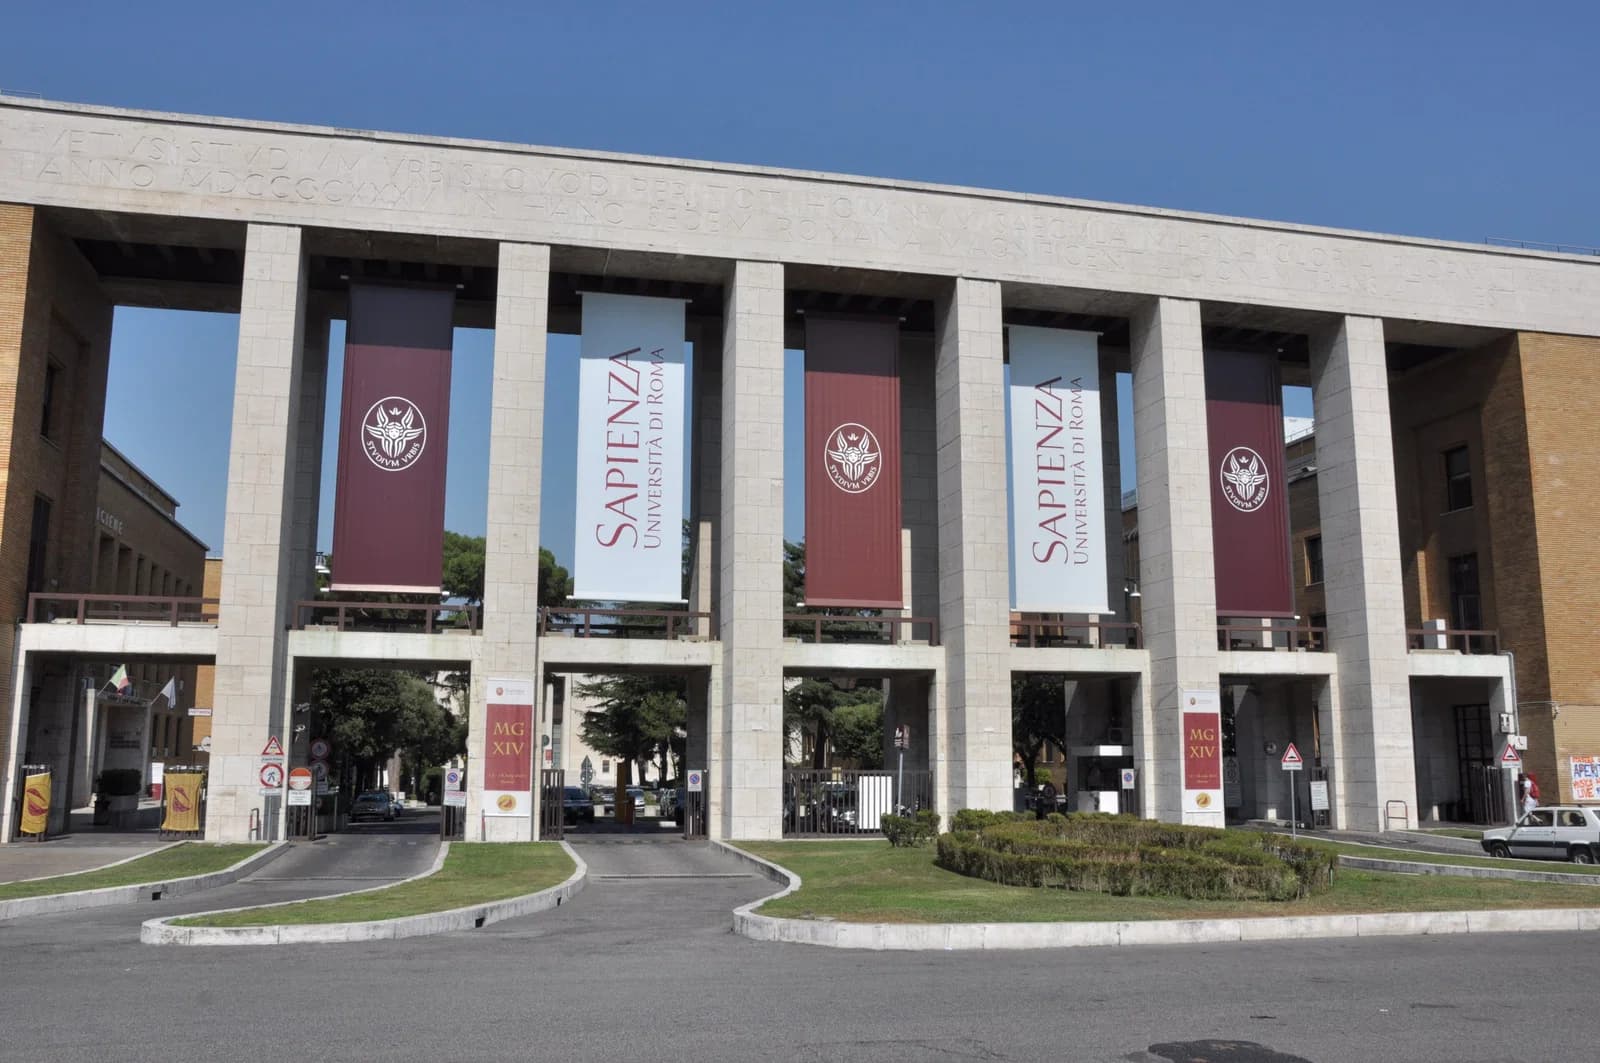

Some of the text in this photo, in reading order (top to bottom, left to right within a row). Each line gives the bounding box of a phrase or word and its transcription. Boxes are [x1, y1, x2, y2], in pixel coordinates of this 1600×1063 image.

[36, 153, 154, 188] ANNO
[383, 156, 472, 186] VRBIS
[502, 166, 608, 199] QVOD
[367, 440, 420, 467] STVDIVM VRBIS
[596, 347, 641, 549] SAPIENZA
[644, 348, 664, 549] UNIVERSITÀ DI ROMA
[829, 464, 860, 489] STVDIVM
[1032, 376, 1068, 565] SAPIENZA
[1069, 377, 1089, 565] UNIVERSITÀ DI ROMA
[493, 722, 525, 736] MG
[1190, 729, 1215, 741] MG
[493, 742, 525, 755] XIV
[1190, 746, 1216, 758] XIV
